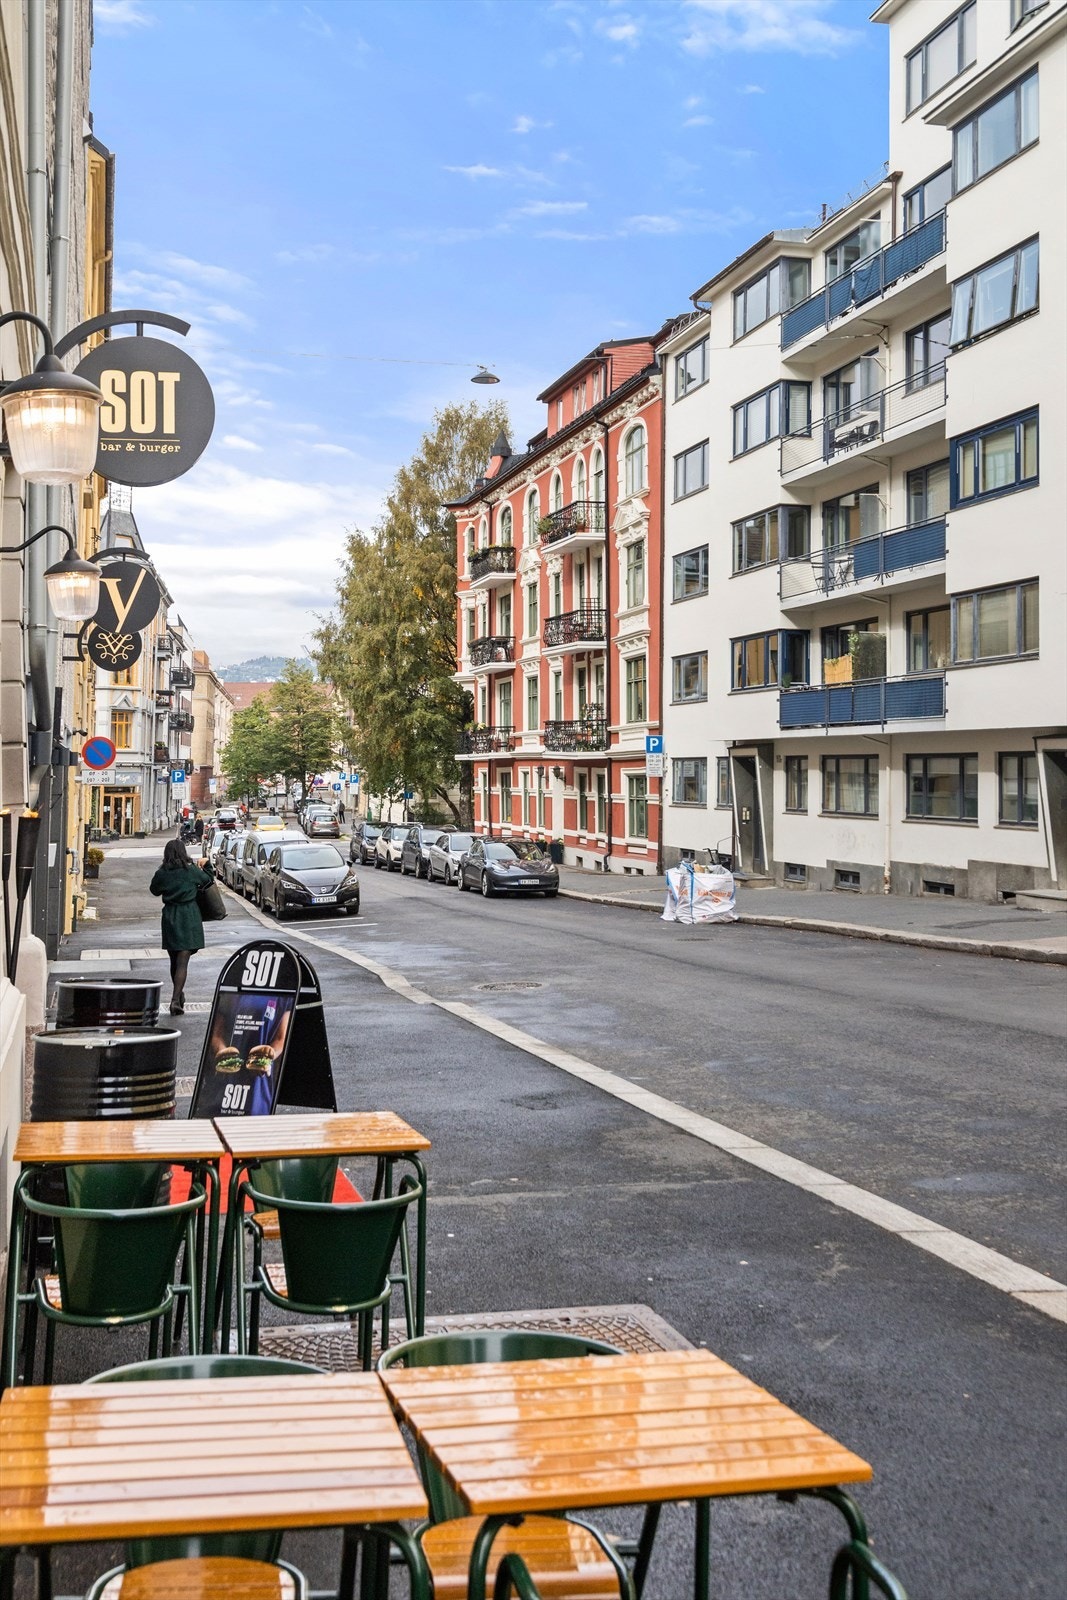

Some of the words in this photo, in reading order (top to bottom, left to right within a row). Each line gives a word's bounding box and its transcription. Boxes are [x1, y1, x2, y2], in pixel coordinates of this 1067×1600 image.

[100, 369, 180, 434] SOT
[100, 443, 121, 451] bar
[125, 443, 135, 452] &
[139, 443, 181, 454] burger
[650, 737, 659, 751] P
[174, 772, 182, 781] P
[242, 950, 285, 987] SOT
[221, 1084, 250, 1110] SOT
